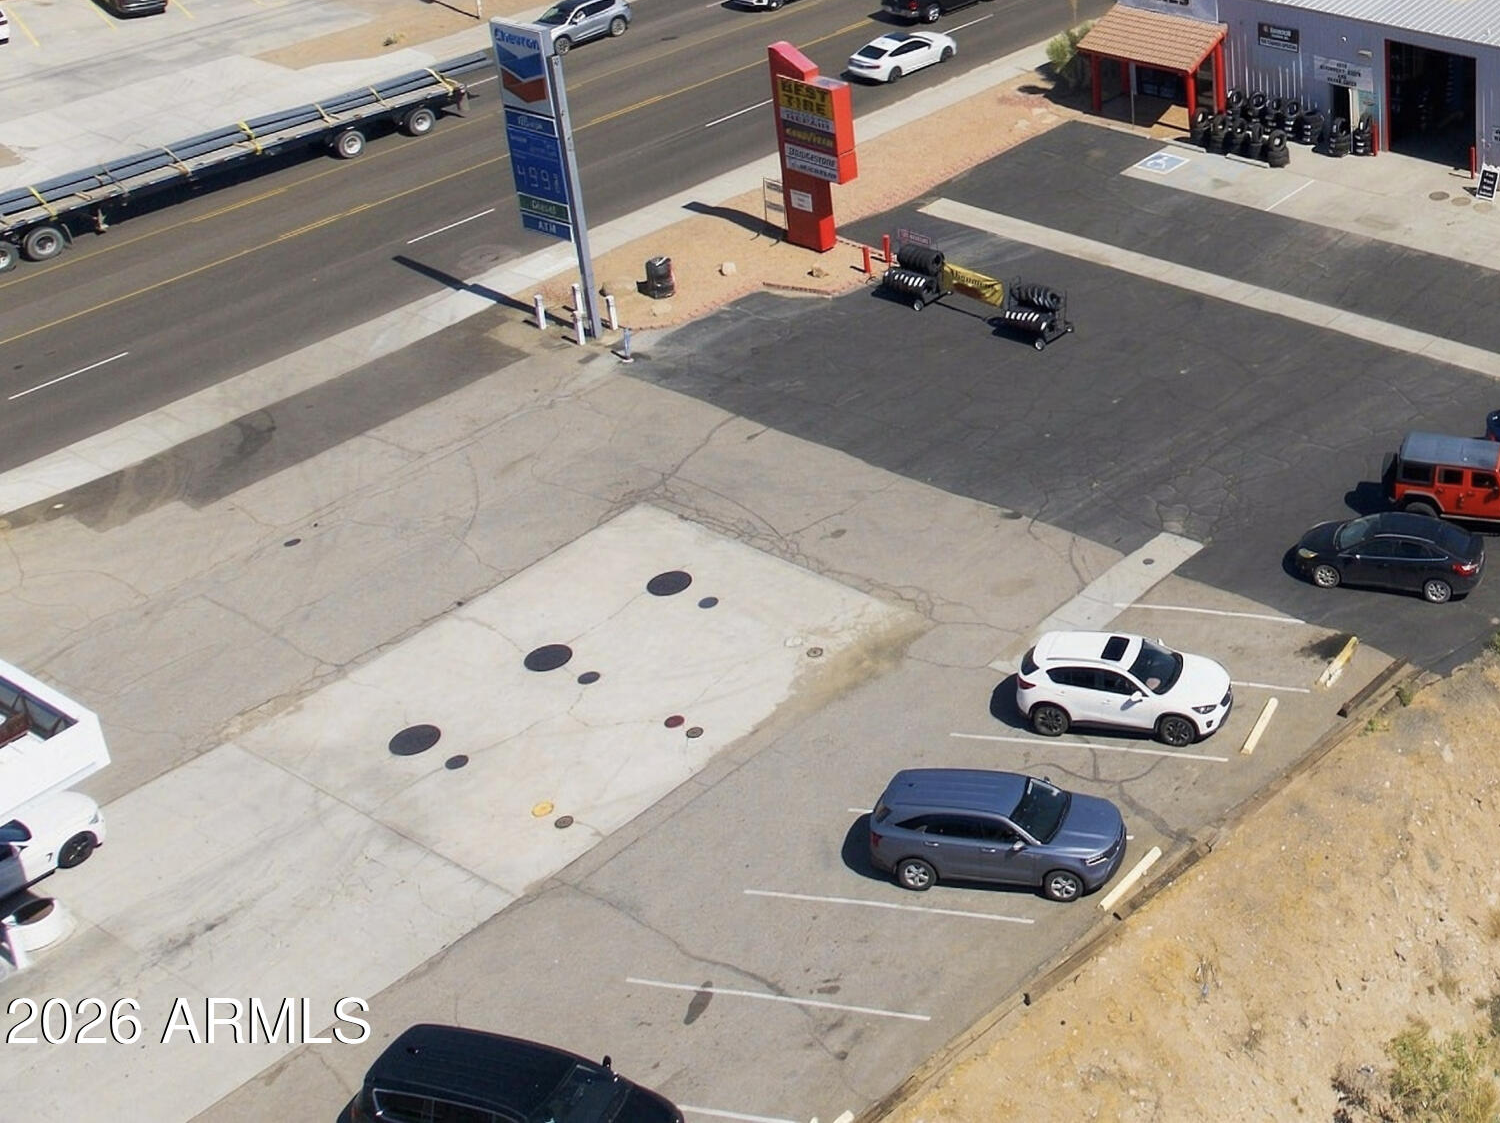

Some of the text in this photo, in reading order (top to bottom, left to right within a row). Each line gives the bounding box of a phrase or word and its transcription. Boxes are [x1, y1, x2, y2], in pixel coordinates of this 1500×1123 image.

[494, 27, 540, 51] Chevron
[781, 80, 829, 102] BEST
[783, 94, 826, 115] TIRE
[538, 221, 557, 234] ATM
